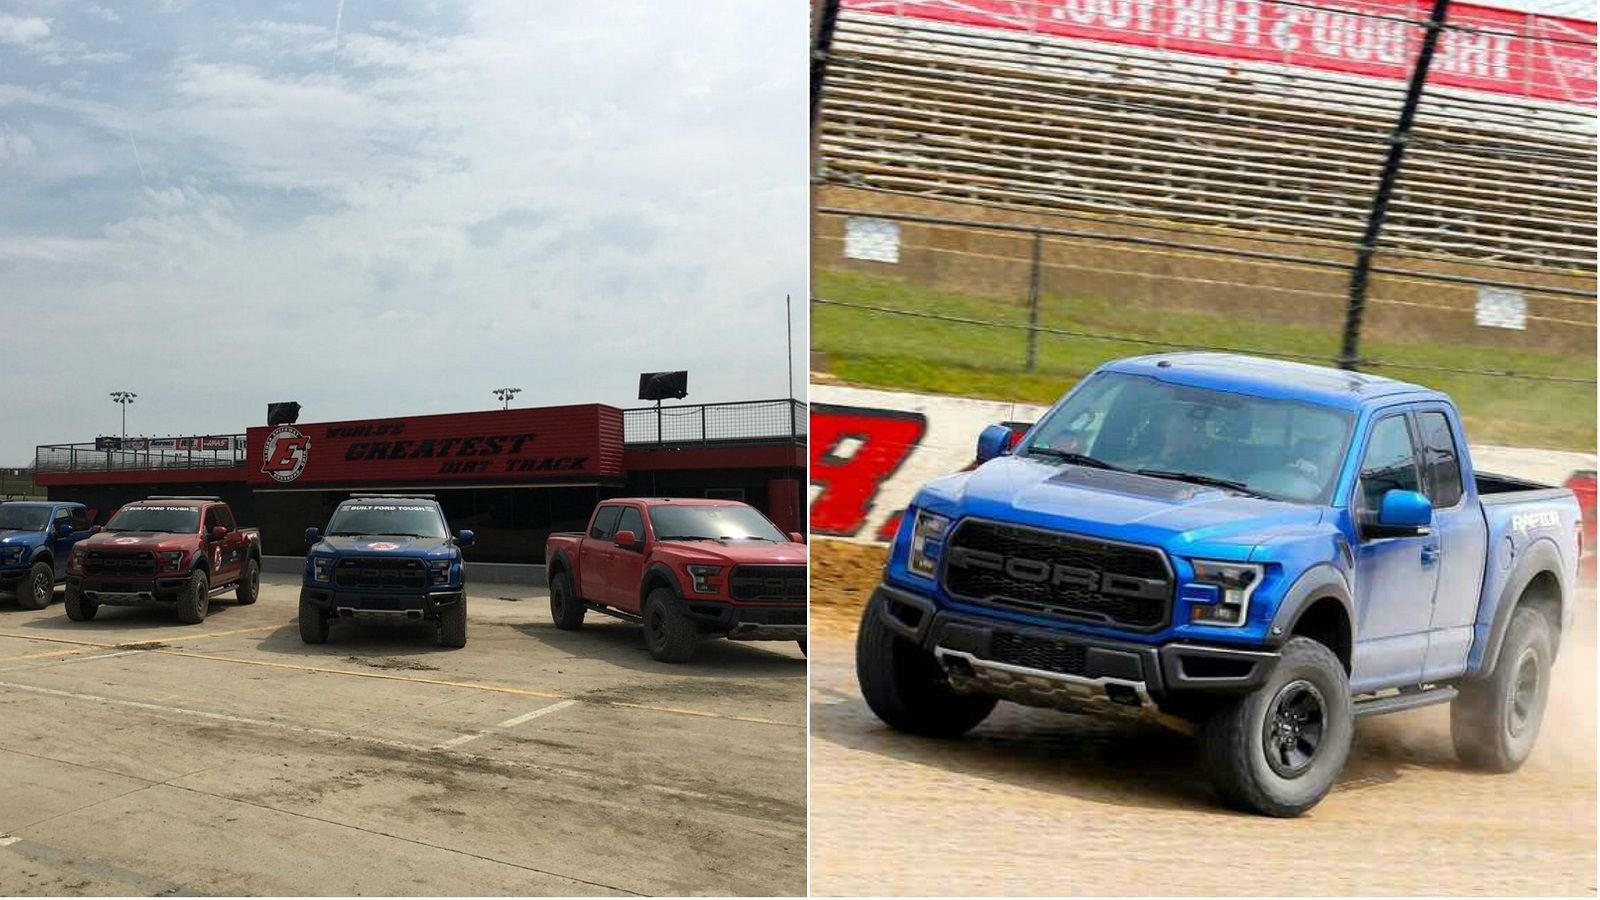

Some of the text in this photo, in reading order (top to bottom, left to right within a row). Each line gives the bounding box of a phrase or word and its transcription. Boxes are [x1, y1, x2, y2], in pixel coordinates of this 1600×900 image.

[326, 422, 405, 438] WORLD'S
[345, 433, 536, 460] GREATEST
[438, 456, 590, 474] DIRT TRACK
[1511, 511, 1562, 535] RAPTOR
[951, 546, 1169, 600] FORD
